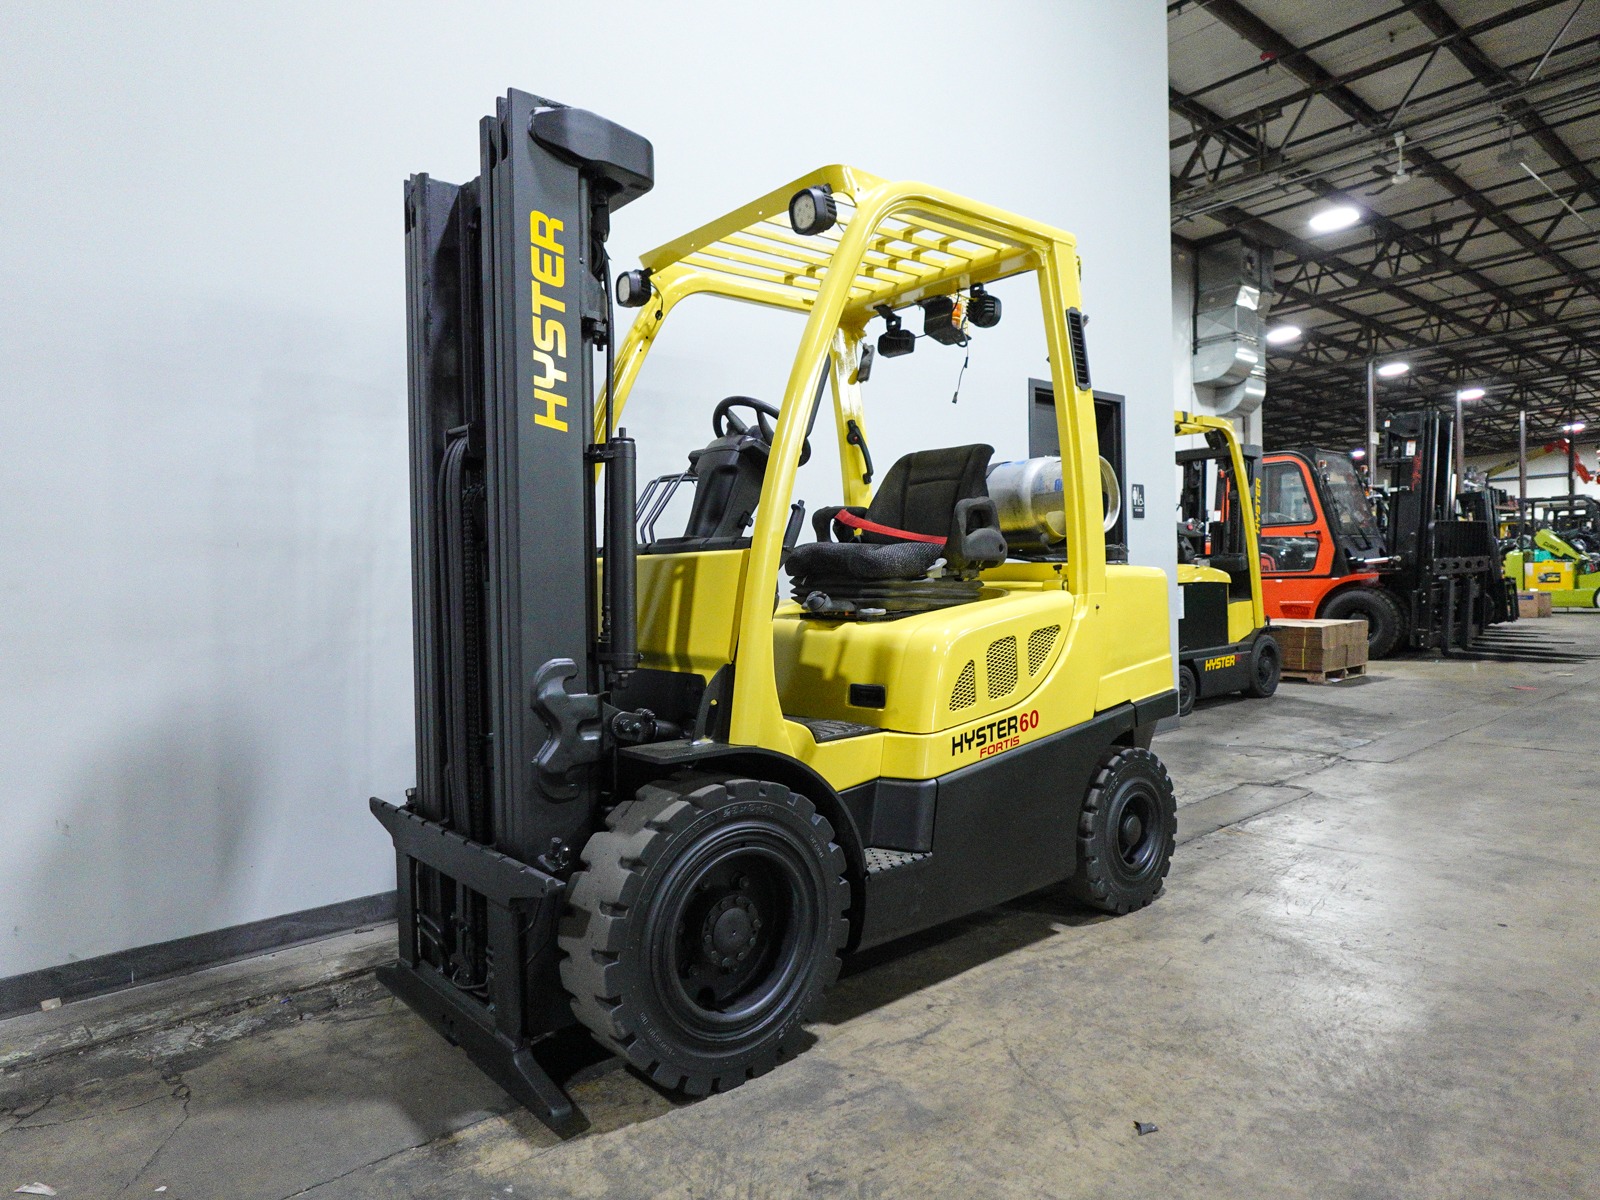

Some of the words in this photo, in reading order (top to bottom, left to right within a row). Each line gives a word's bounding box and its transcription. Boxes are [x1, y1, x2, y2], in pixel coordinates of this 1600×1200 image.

[530, 210, 568, 432] HYSTER
[1205, 655, 1236, 671] HYSTER
[980, 736, 1020, 758] FORTIS
